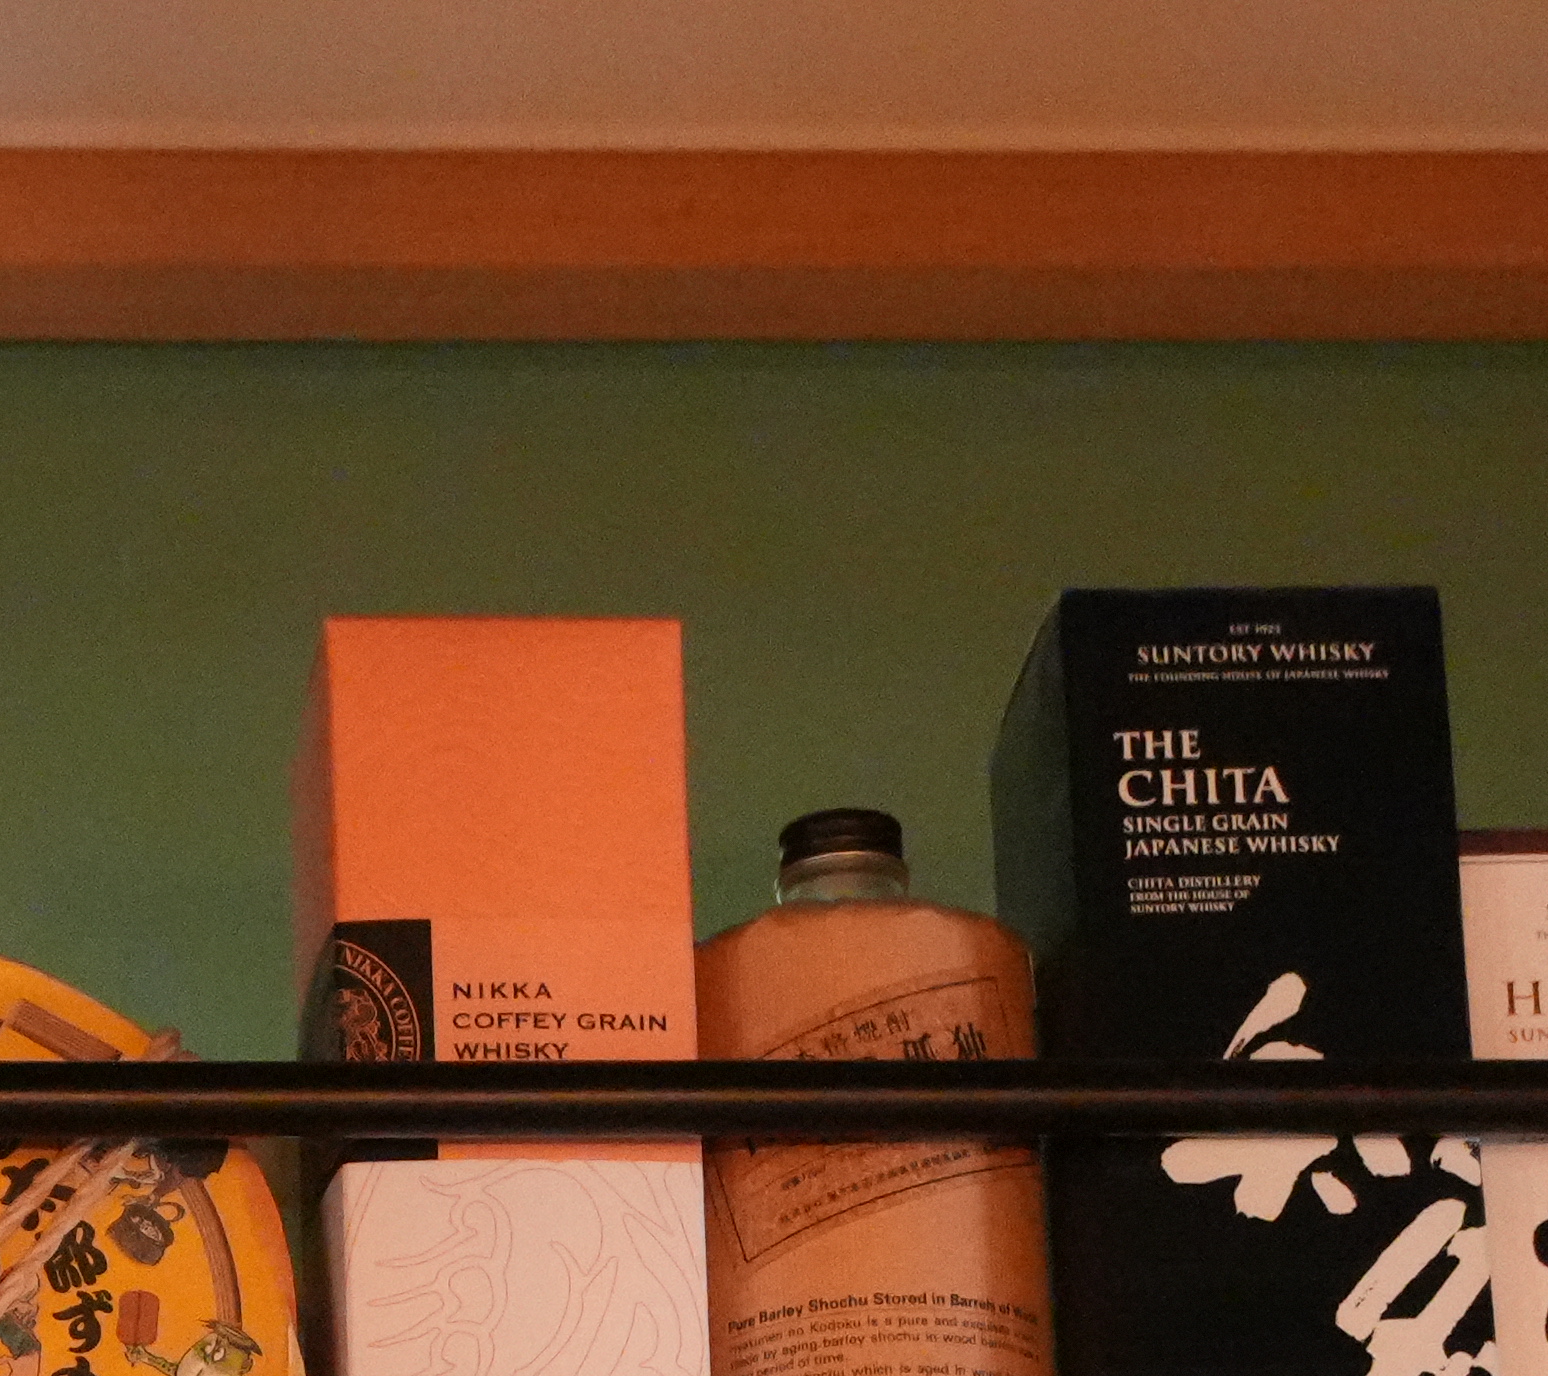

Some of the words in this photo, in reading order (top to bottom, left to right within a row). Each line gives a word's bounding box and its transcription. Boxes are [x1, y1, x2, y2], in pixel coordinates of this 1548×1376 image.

[1137, 643, 1262, 665] SUNTORY
[1270, 642, 1375, 663] WHISKY
[1113, 730, 1201, 761] THE
[1118, 766, 1290, 808] CHITA
[1123, 815, 1206, 834] SINGLE
[1212, 813, 1289, 832] GRAIN
[1125, 837, 1240, 860] JAPANESE
[1246, 835, 1341, 854] WHISKY
[1127, 877, 1174, 891] CHITA
[1178, 875, 1261, 890] DISTILLERY
[1235, 888, 1250, 900] OF
[1130, 902, 1185, 914] SUNTORY
[1189, 901, 1235, 913] WHISKY
[453, 982, 553, 1000] NIKKA
[453, 1012, 567, 1031] COFFEY
[577, 1012, 668, 1031] GRAIN
[454, 1042, 569, 1060] WHISKY
[727, 1316, 756, 1335] Pure
[758, 1304, 803, 1324] Barley
[807, 1294, 869, 1313] Shochu
[872, 1291, 927, 1306] Stored
[931, 1292, 946, 1305] in
[897, 1315, 929, 1329] pure
[933, 1315, 958, 1328] and
[781, 1339, 819, 1357] aging
[822, 1333, 865, 1348] barley
[870, 1331, 921, 1344] shochu
[944, 1334, 977, 1346] wood
